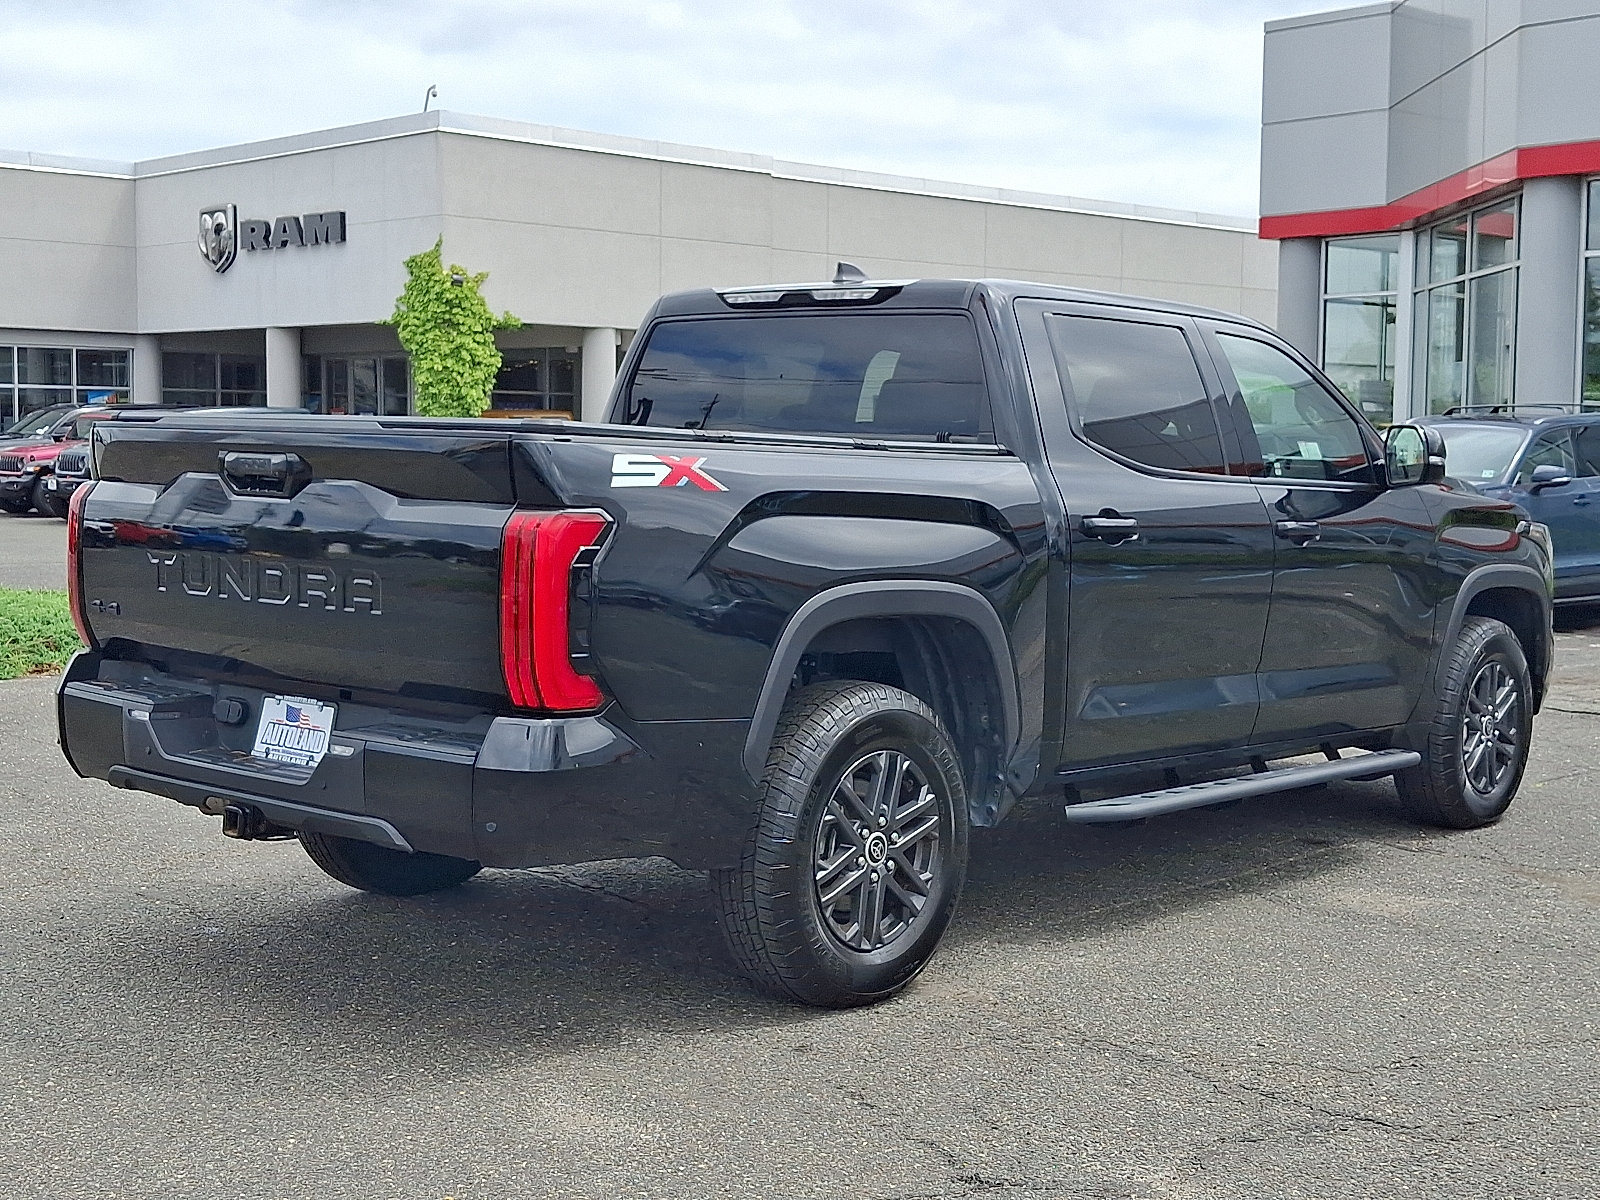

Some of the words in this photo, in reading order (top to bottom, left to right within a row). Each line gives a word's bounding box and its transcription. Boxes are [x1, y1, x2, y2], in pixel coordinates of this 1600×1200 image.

[240, 211, 346, 251] RAM
[610, 453, 730, 492] SX
[146, 551, 383, 615] TUNDRA
[261, 721, 326, 754] AUTOLAND
